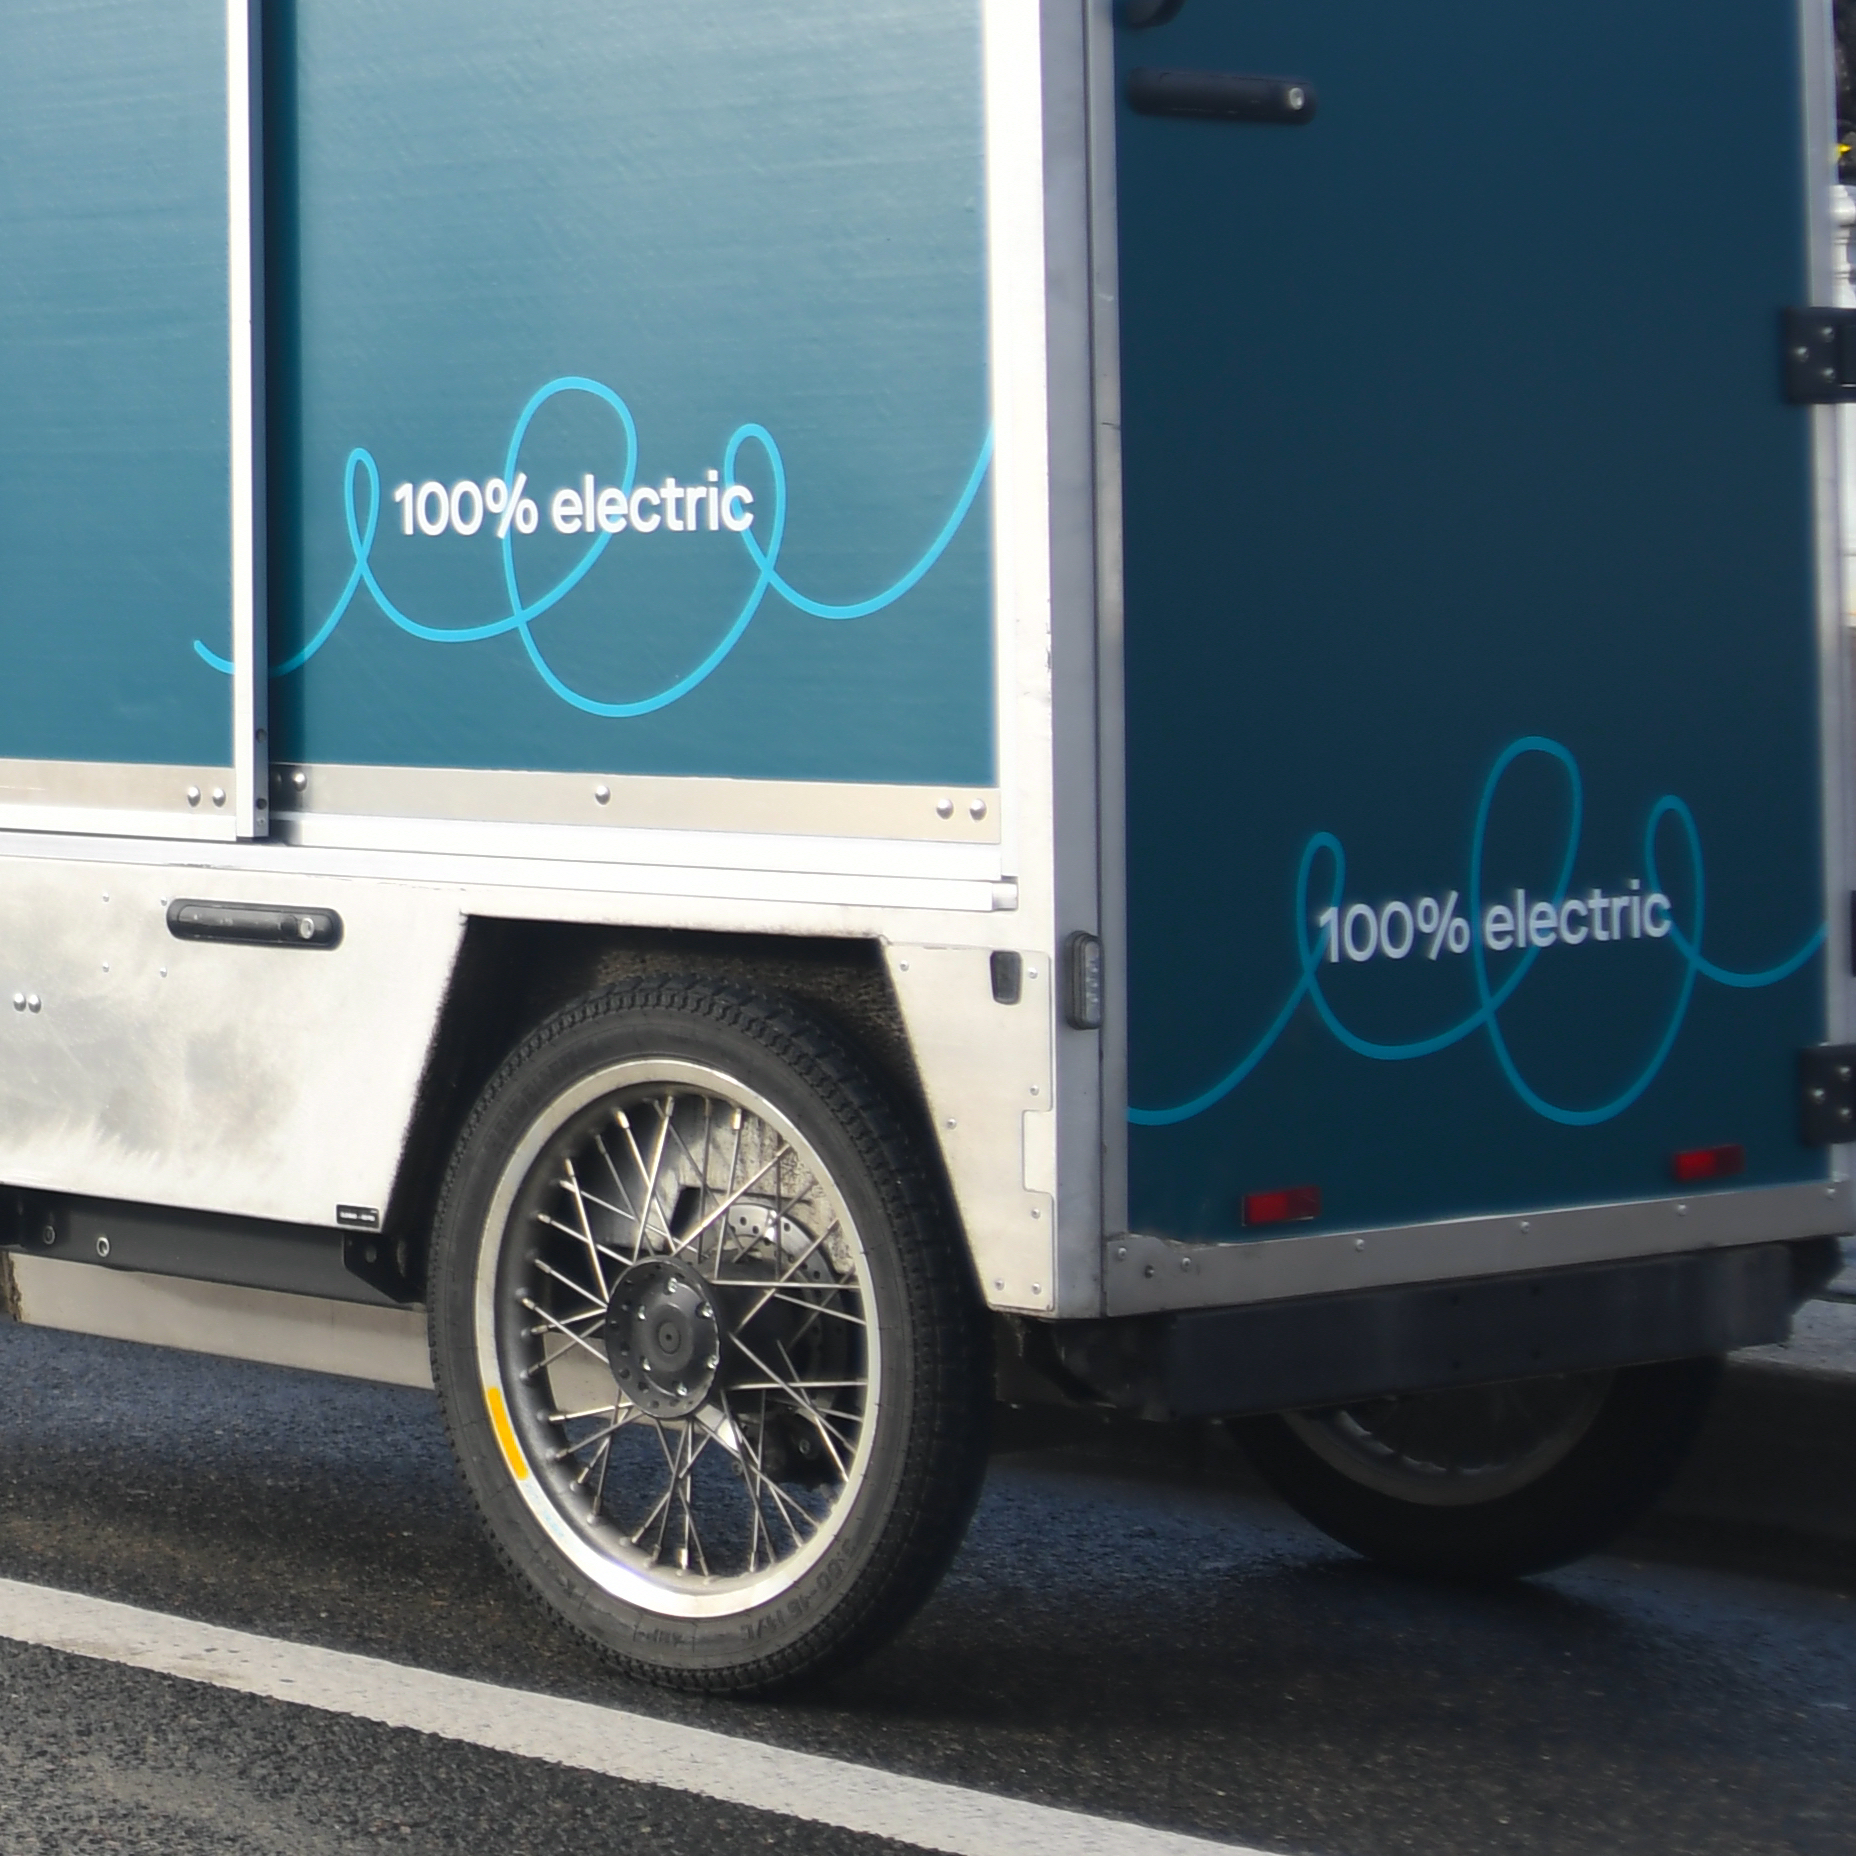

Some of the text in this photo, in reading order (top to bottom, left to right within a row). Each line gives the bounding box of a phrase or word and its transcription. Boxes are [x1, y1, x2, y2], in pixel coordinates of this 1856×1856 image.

[394, 470, 755, 539] 100% electric
[1319, 878, 1674, 963] 100% electric
